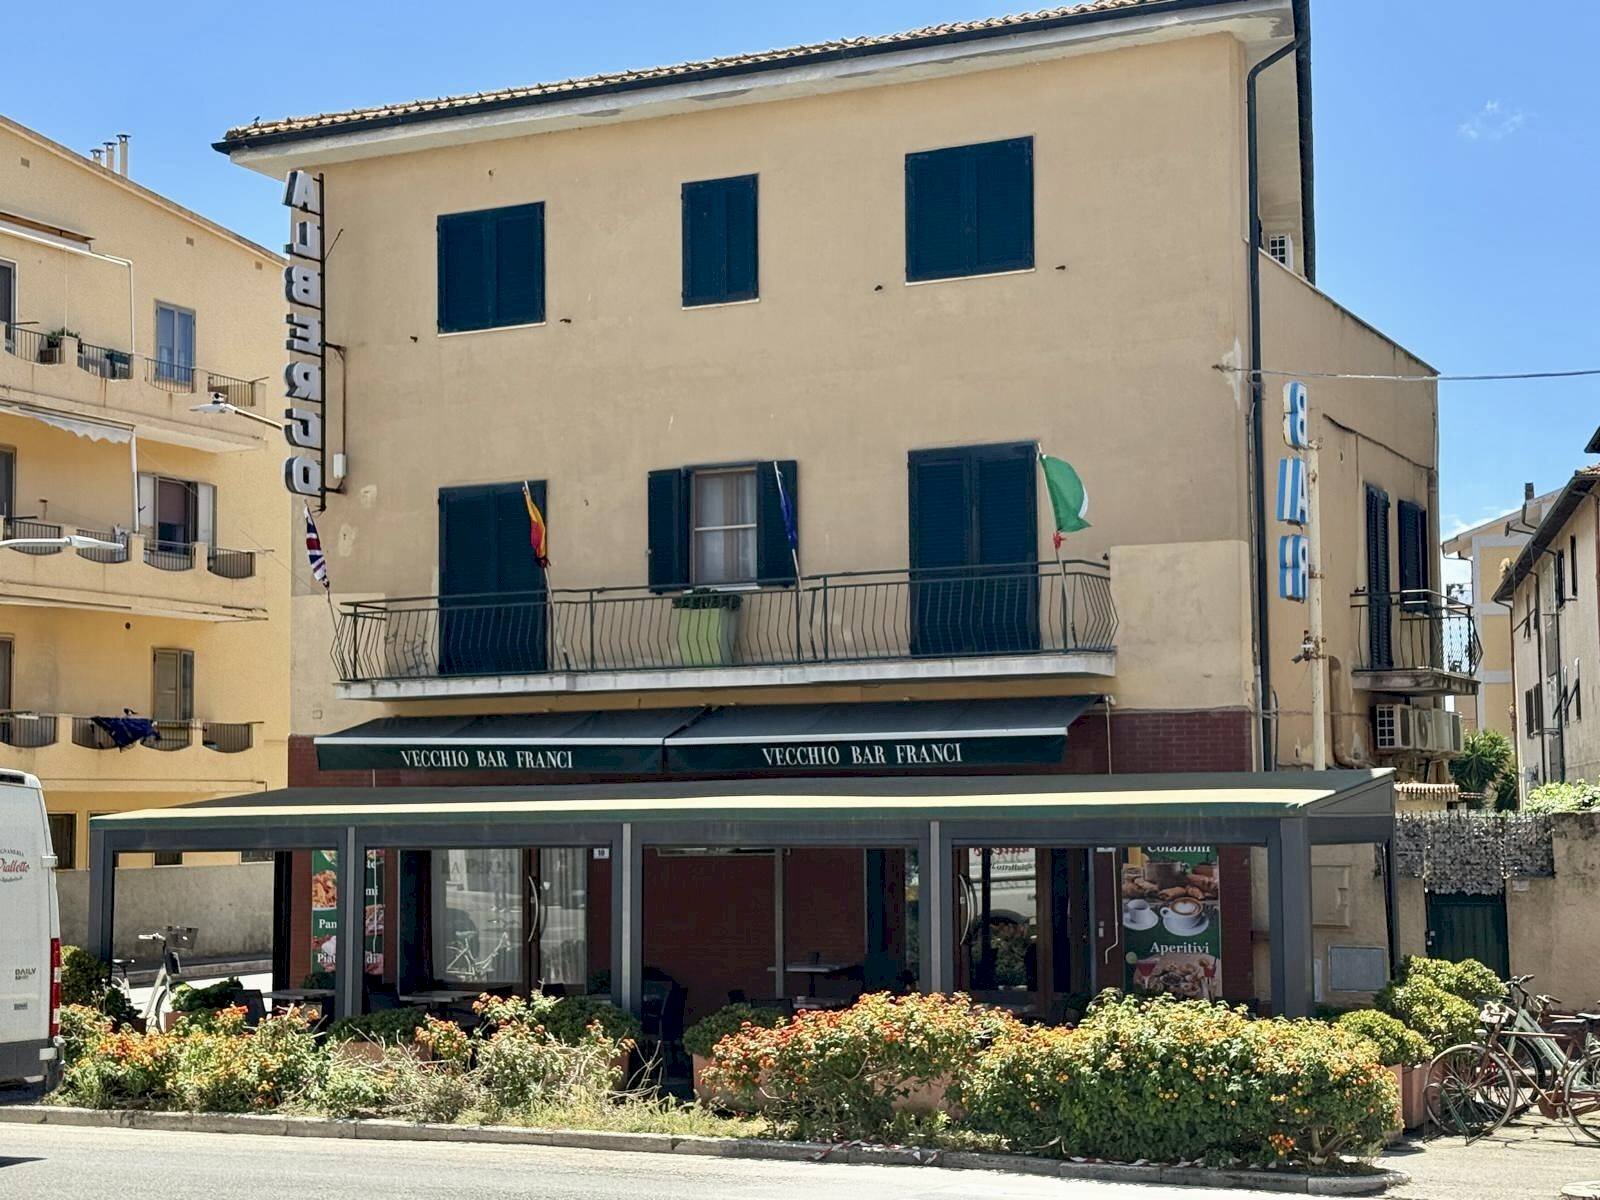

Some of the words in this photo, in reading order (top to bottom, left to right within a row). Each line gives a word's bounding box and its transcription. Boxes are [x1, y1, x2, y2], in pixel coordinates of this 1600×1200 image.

[400, 750, 469, 767] VECCHIO
[477, 750, 509, 767] BAR
[516, 750, 573, 768] FRANCI
[762, 745, 840, 765] VECCHIO
[850, 744, 886, 764] BAR
[895, 743, 963, 763] FRANCI
[1149, 942, 1209, 955] Aperitivi
[15, 968, 36, 976] DAILY
